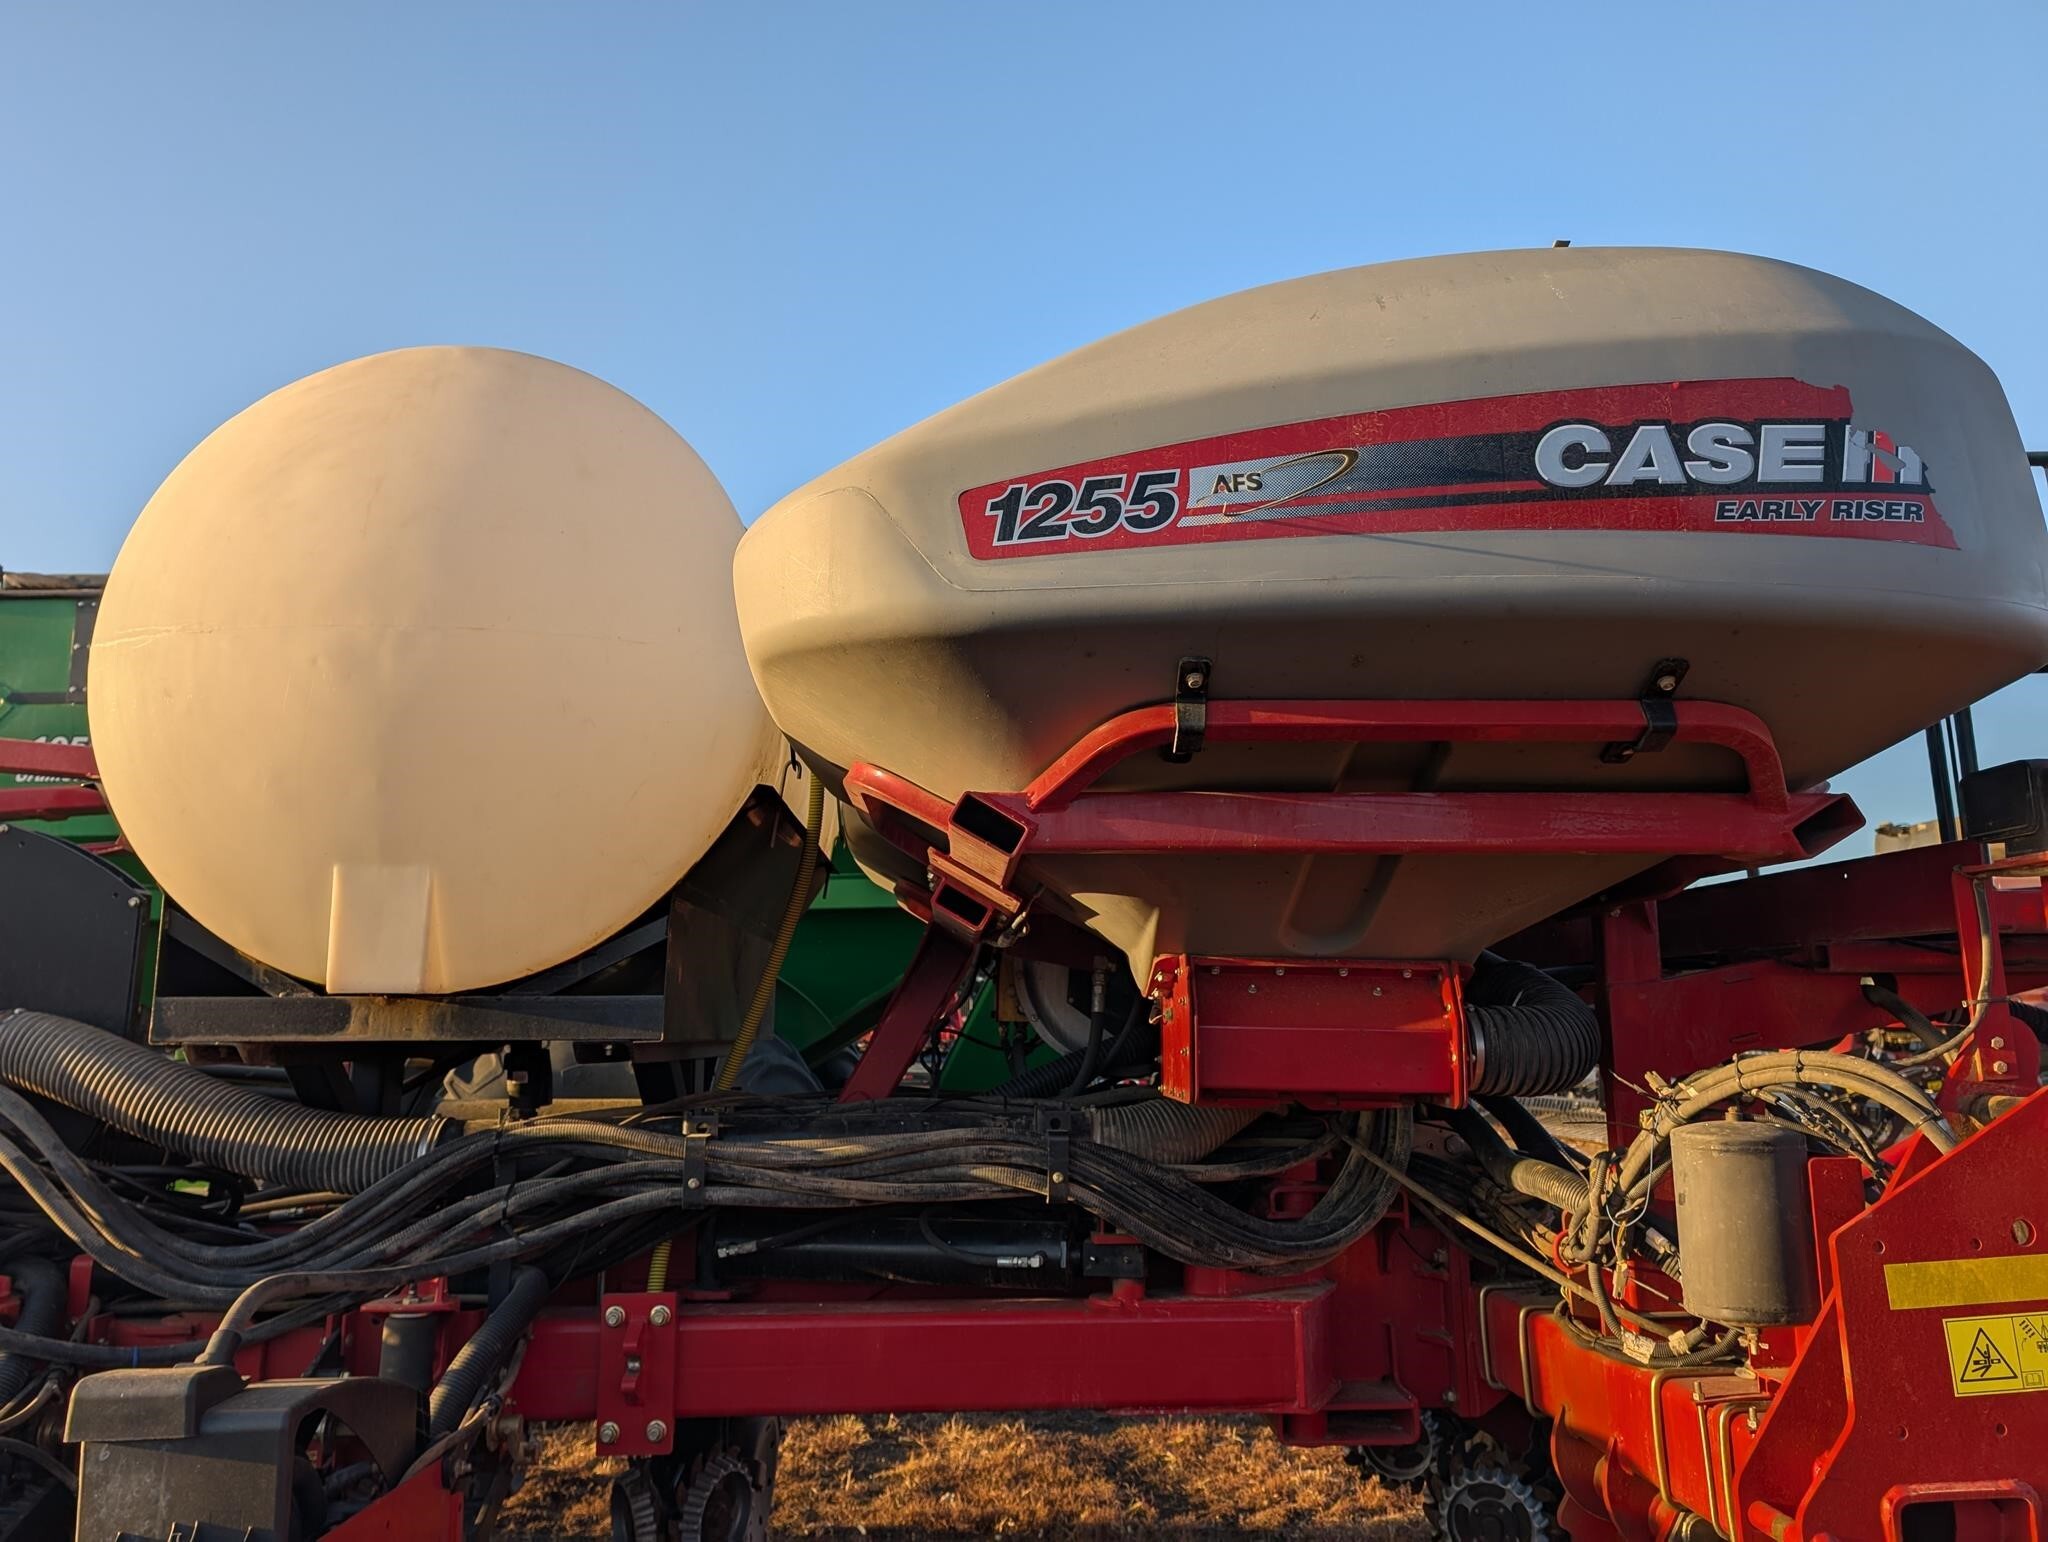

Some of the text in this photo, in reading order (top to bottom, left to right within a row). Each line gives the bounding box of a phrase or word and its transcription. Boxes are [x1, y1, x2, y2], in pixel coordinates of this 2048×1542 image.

[1535, 423, 1826, 488] CASE
[1212, 472, 1263, 494] AFS
[985, 468, 1180, 547] 1255
[1715, 500, 1925, 523] EARLY RISER
